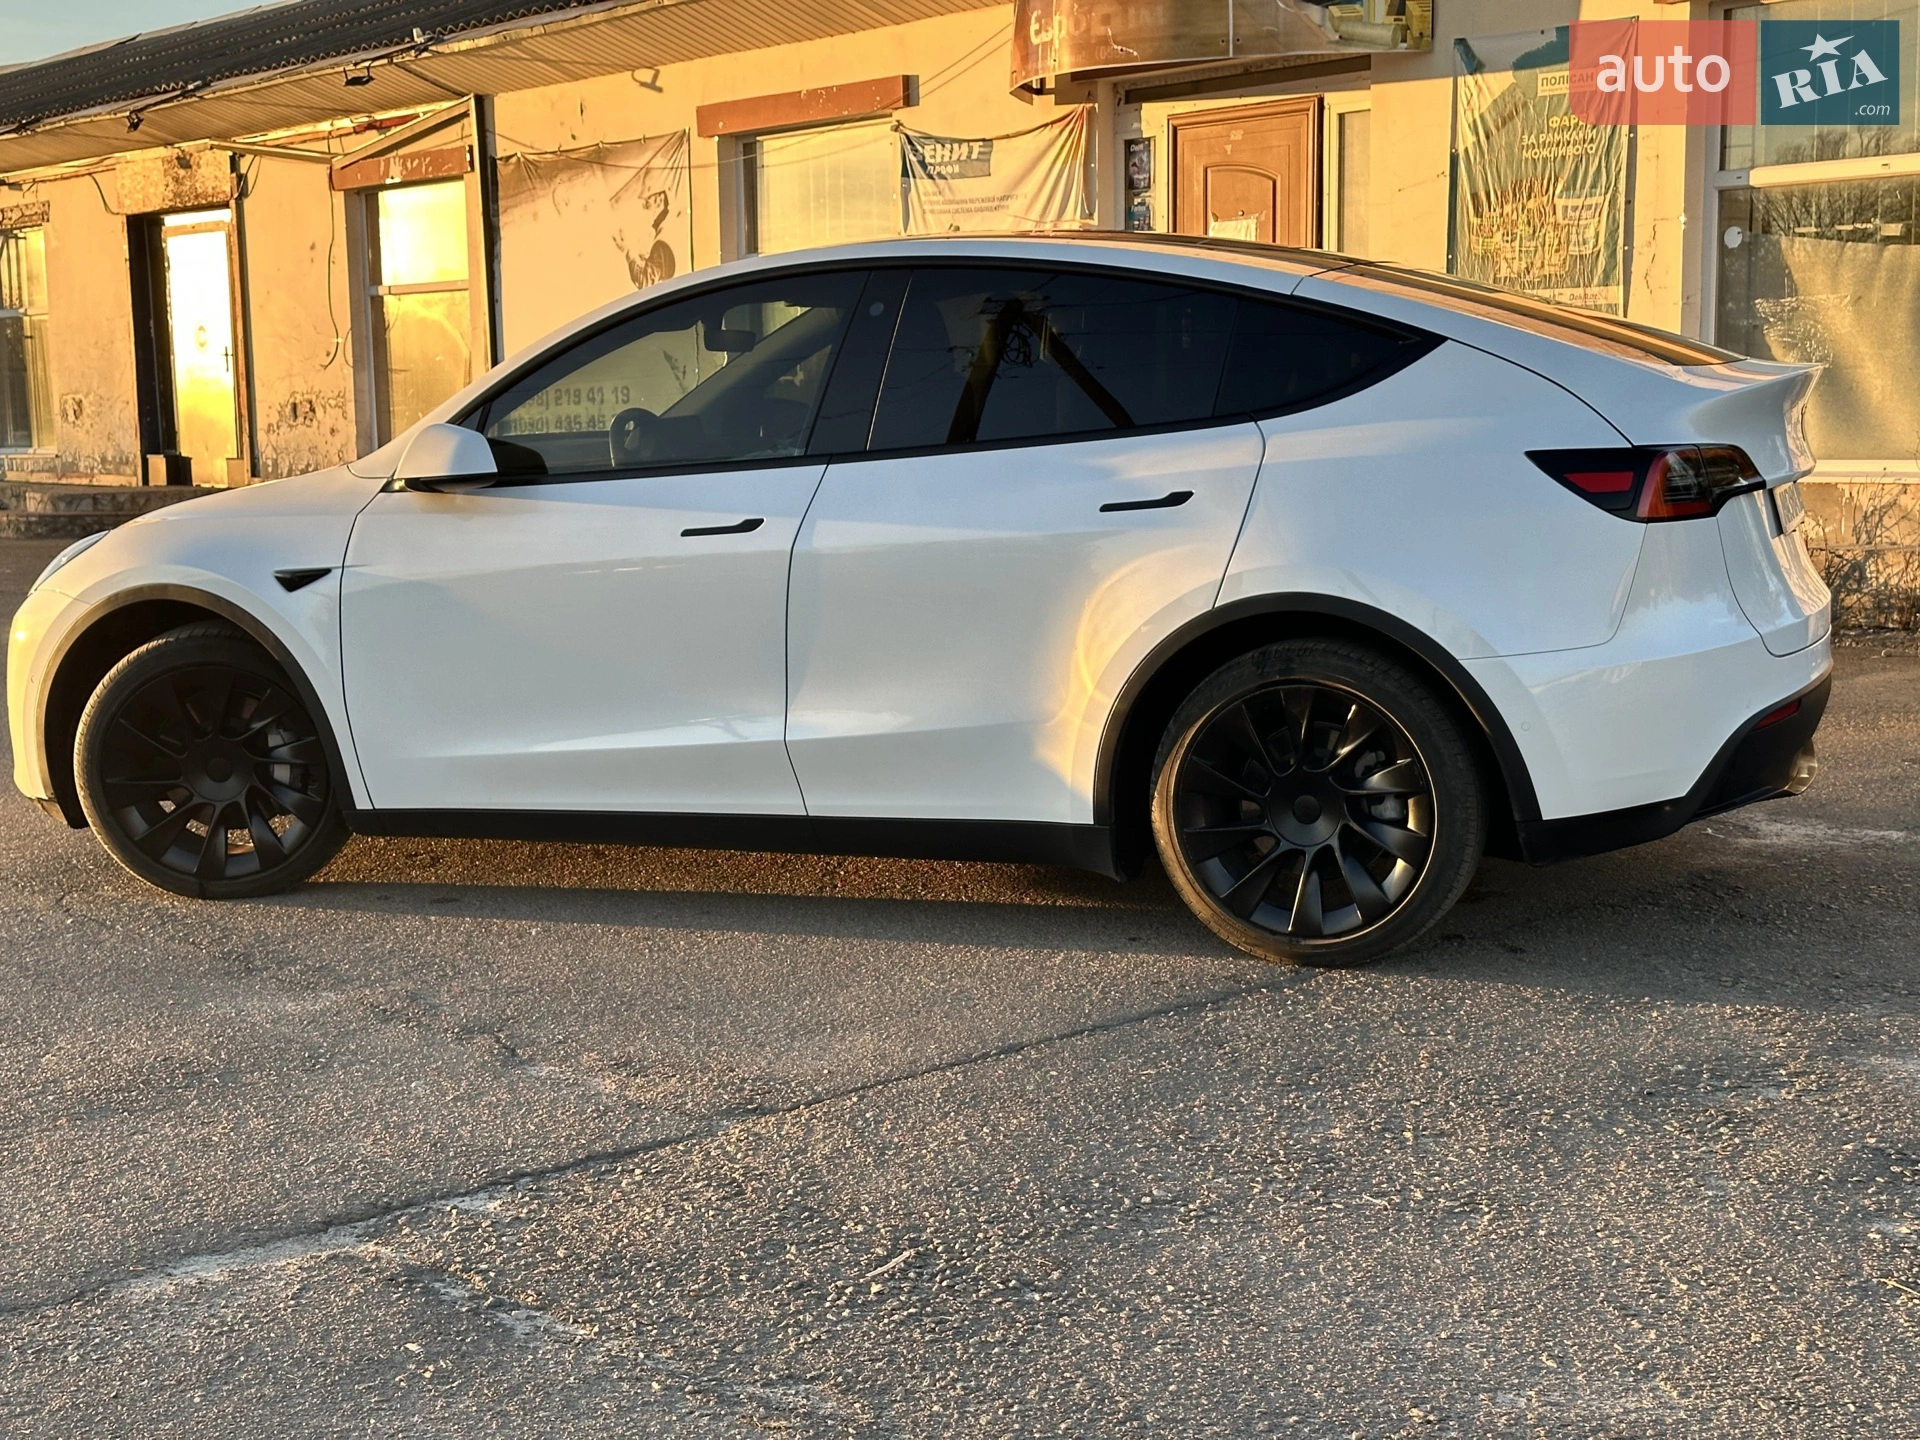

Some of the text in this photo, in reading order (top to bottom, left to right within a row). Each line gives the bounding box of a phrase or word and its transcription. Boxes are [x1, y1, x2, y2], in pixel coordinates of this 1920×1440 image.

[1541, 72, 1594, 87] ПОЛІСАН
[1521, 132, 1537, 146] ЗА
[611, 385, 630, 405] 19
